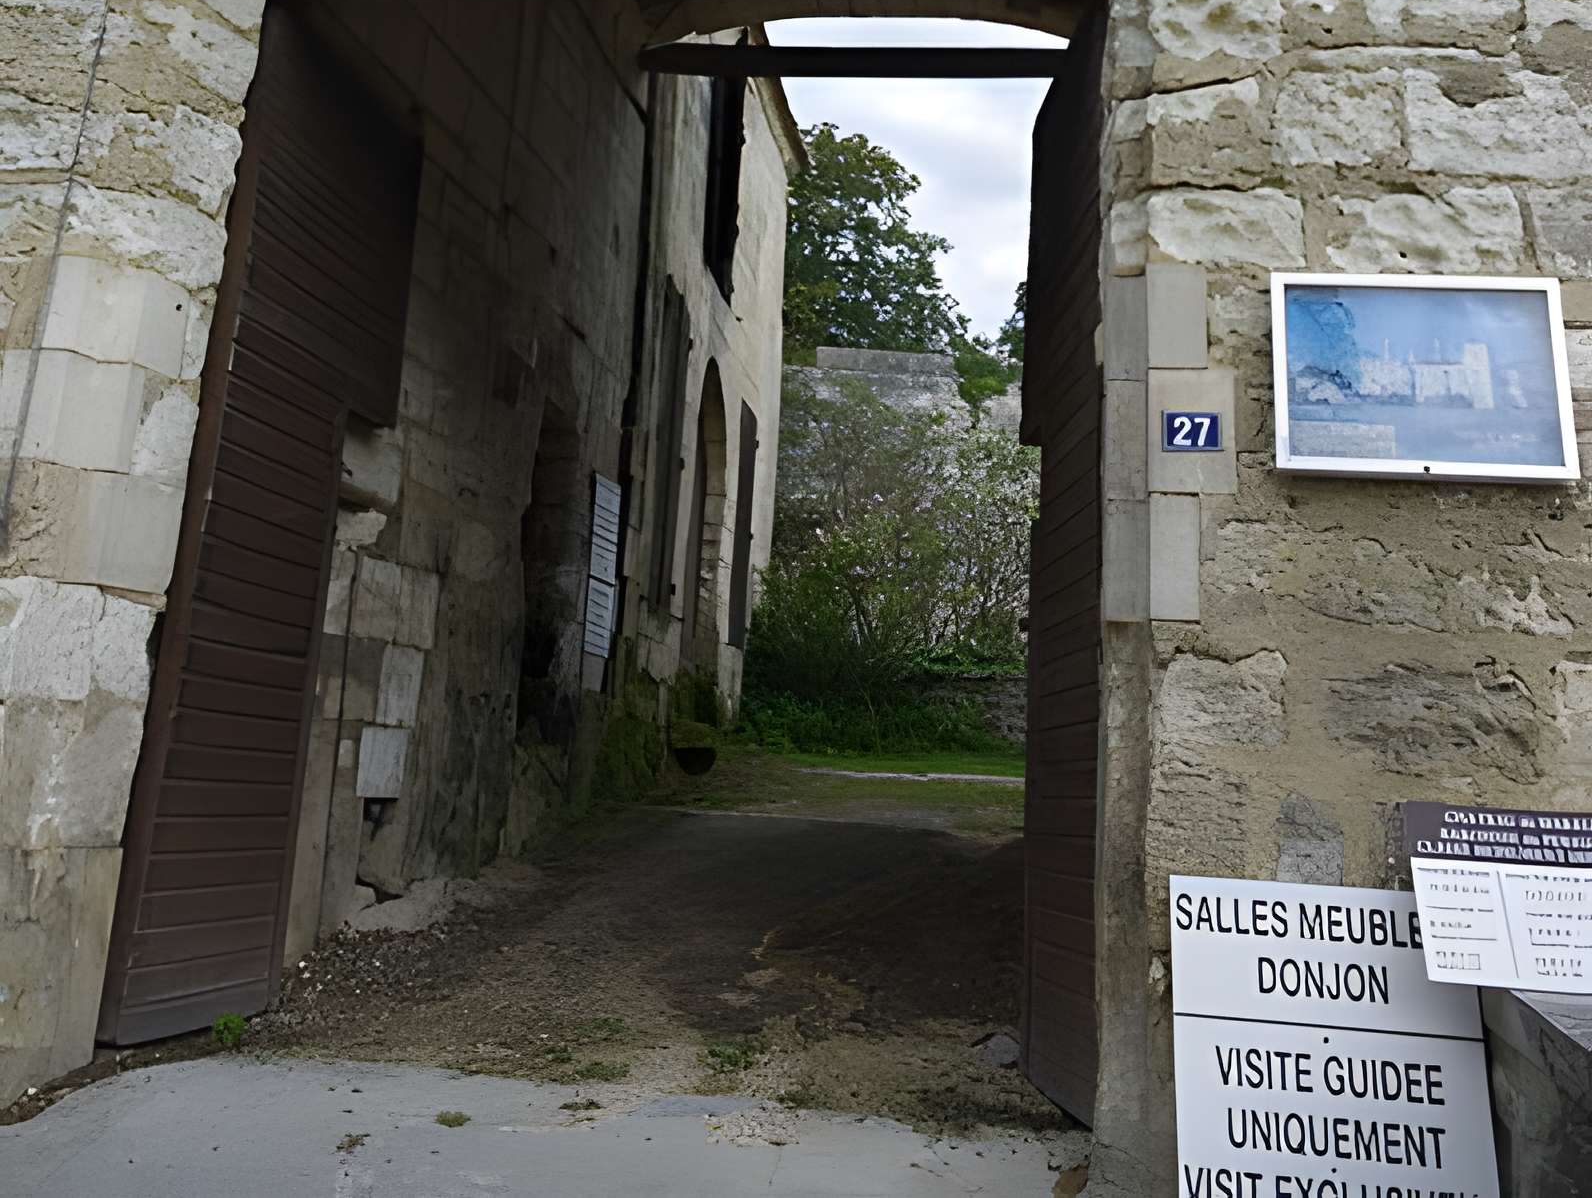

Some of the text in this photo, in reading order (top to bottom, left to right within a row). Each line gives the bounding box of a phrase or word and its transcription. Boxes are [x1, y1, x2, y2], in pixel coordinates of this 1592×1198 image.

[1172, 416, 1212, 447] 27
[1175, 893, 1289, 938] SALLES
[1257, 957, 1390, 1004] DONJON
[1215, 1045, 1446, 1106] VISITE GUIDEE
[1227, 1107, 1446, 1169] UNIQUEMENT
[1184, 1164, 1263, 1198] VISIT
